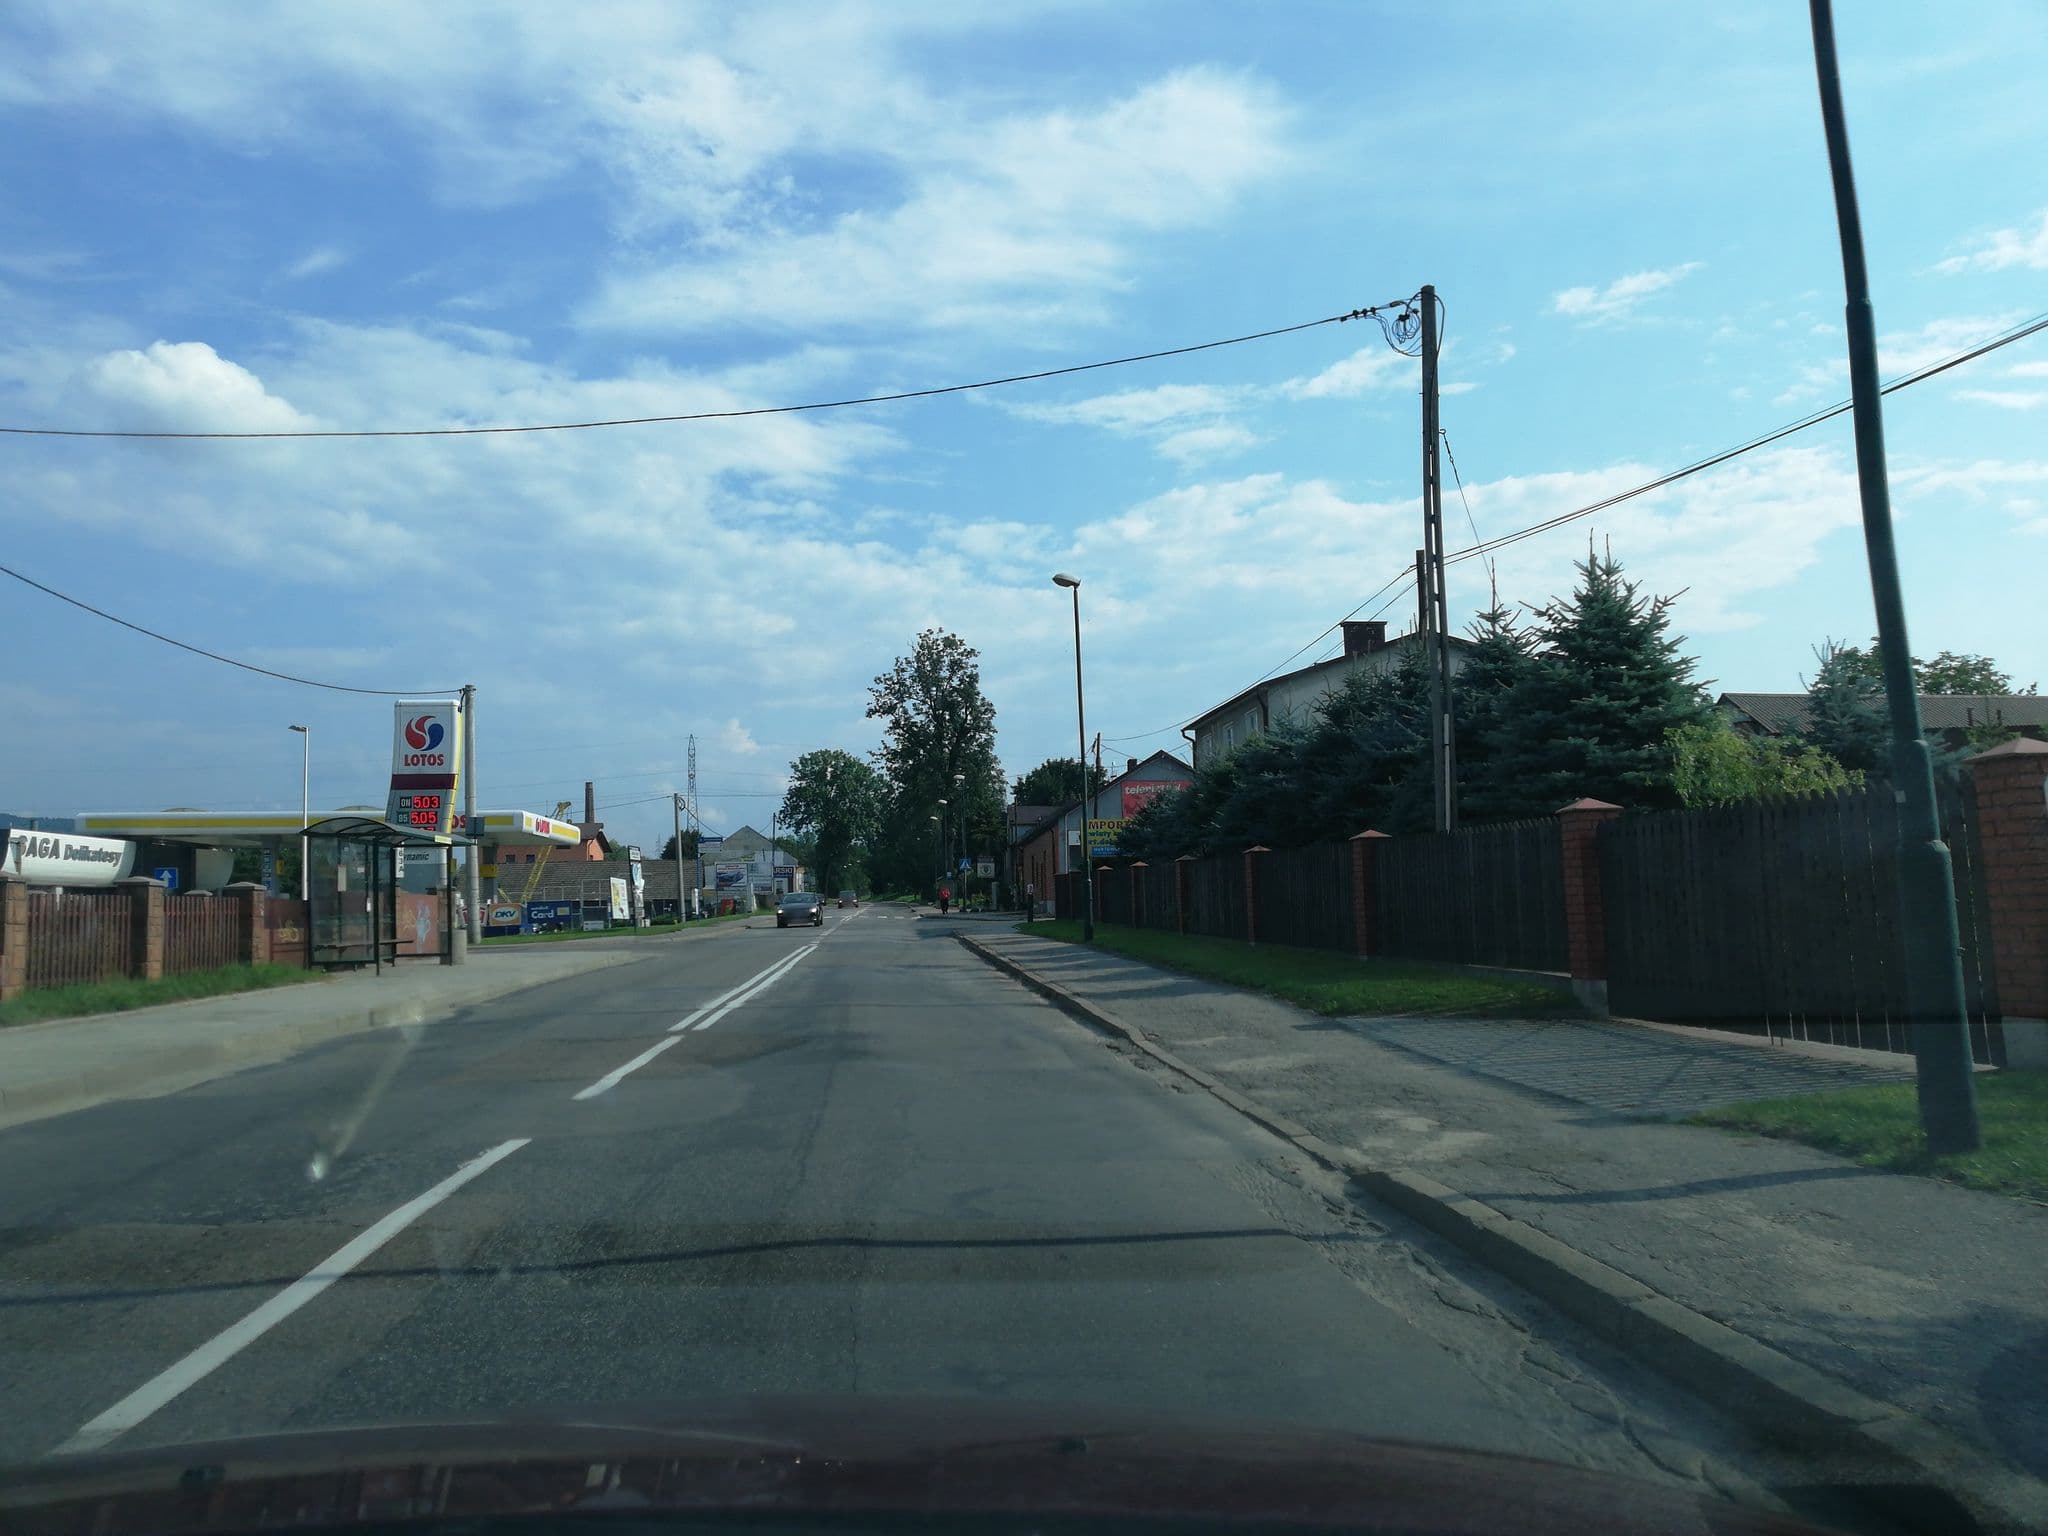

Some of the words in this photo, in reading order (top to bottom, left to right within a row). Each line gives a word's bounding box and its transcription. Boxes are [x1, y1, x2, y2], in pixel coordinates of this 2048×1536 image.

[404, 754, 444, 766] LOTOS
[495, 910, 516, 918] DKV
[531, 909, 554, 919] Card
